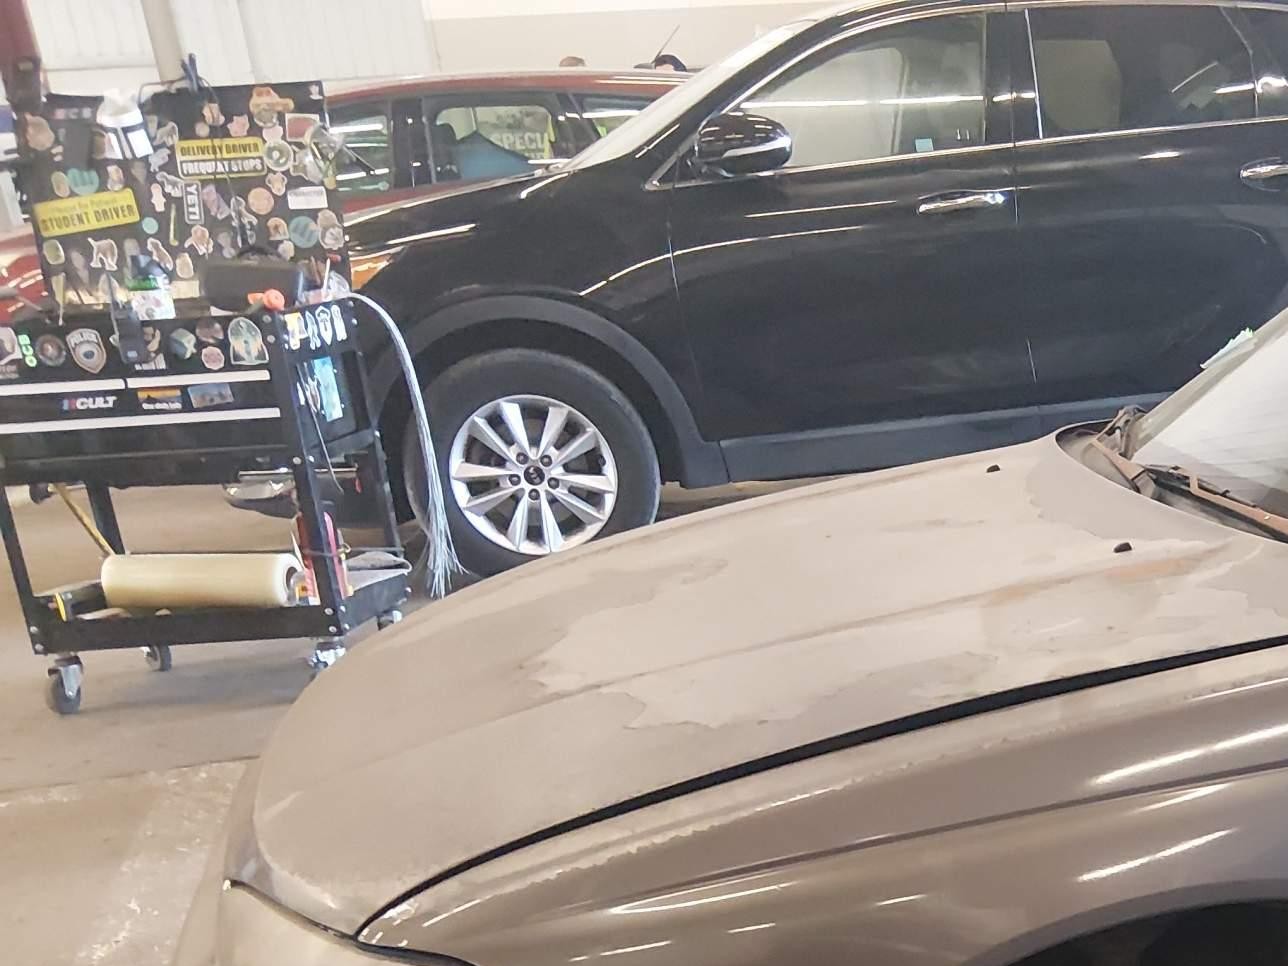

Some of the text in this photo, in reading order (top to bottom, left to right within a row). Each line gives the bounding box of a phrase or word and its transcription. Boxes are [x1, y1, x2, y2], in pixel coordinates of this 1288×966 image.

[180, 142, 260, 156] DELIVERY DRIVER
[230, 158, 263, 172] STOPS
[186, 184, 201, 220] YETI
[40, 211, 91, 232] STUDENT
[94, 203, 136, 223] DRIVER
[75, 396, 117, 410] CULT
